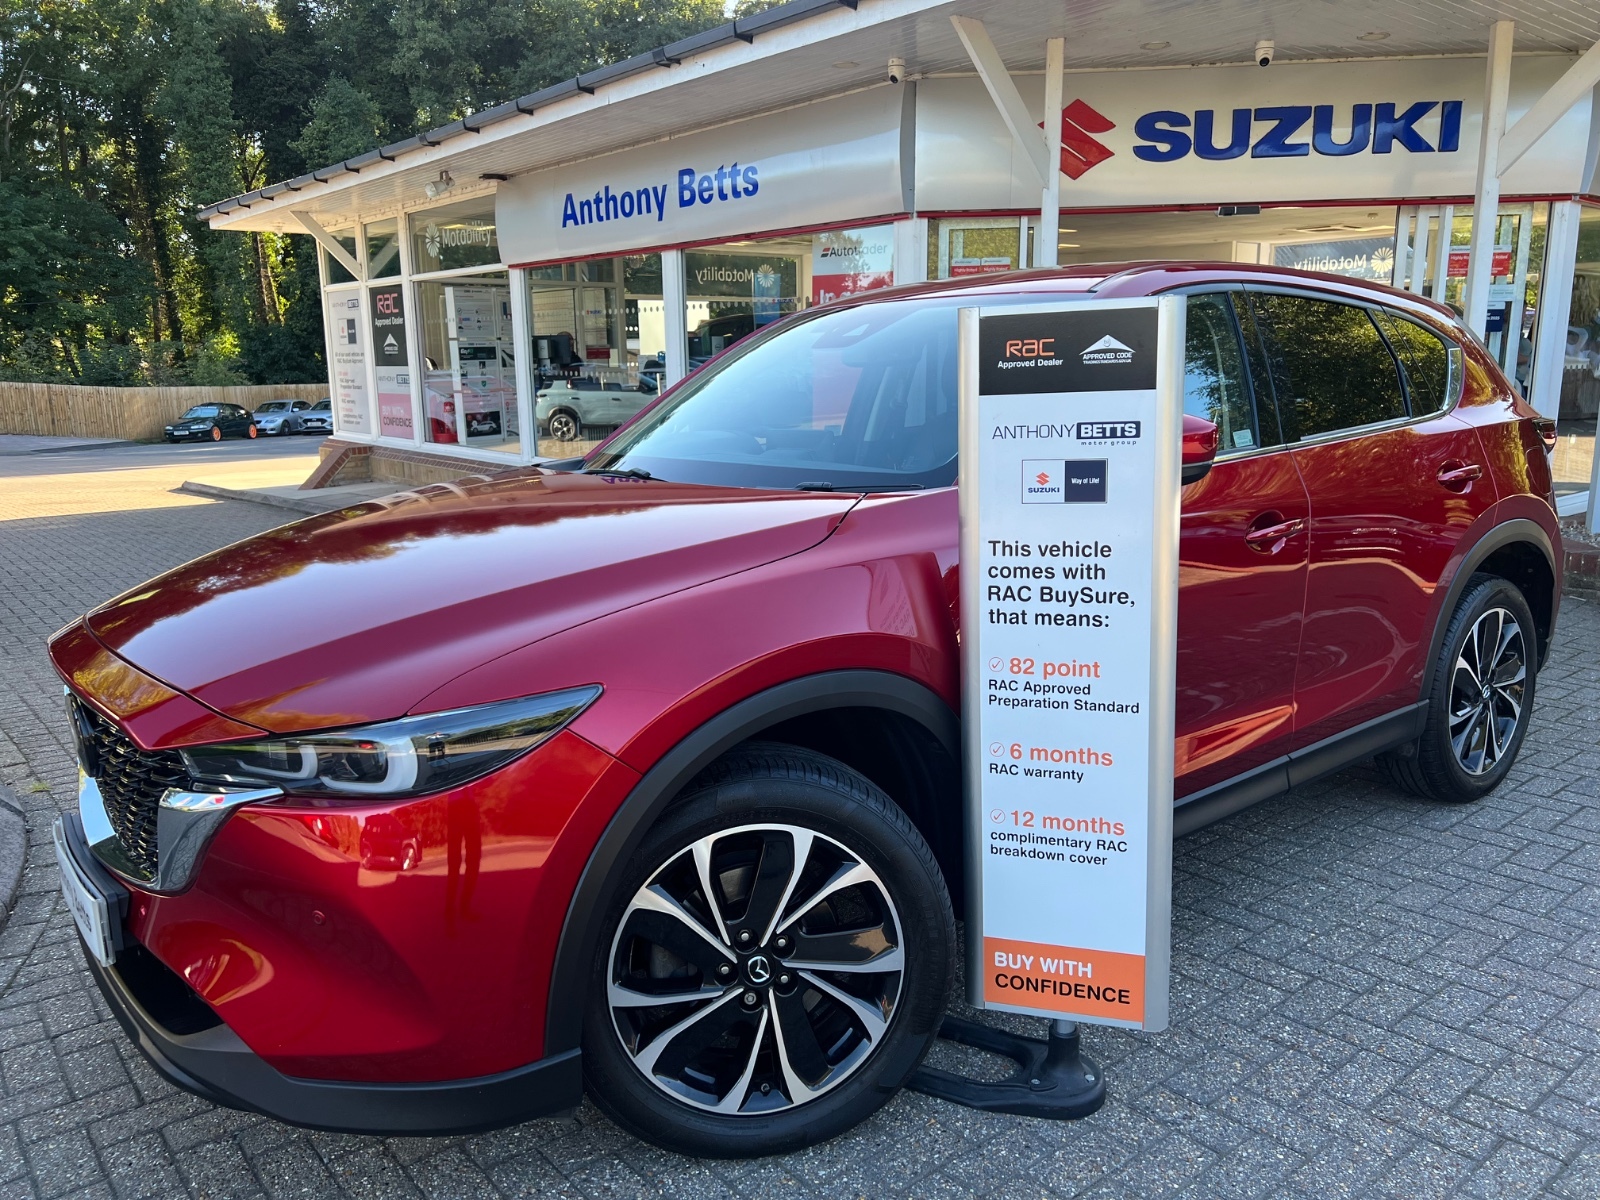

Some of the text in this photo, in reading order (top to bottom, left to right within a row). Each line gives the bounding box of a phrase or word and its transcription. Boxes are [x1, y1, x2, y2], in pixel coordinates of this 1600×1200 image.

[1132, 100, 1463, 162] SUZUKI
[562, 162, 759, 228] Anthony Betts
[442, 220, 491, 248] Motability
[829, 243, 888, 257] Autotrader
[375, 316, 403, 327] Approved Dealer
[998, 358, 1063, 369] Approved Dealer
[383, 416, 412, 428] CONFIDENCE
[992, 423, 1136, 439] ANTHONY BETTS
[988, 540, 1112, 558] This vehicle
[988, 563, 1106, 580] comes with
[988, 585, 1135, 607] RAC BuySure,
[988, 608, 1109, 628] that means:
[1009, 657, 1100, 680] 82 point
[988, 679, 1091, 695] RAC Approved
[988, 694, 1140, 714] Preparation Standard
[1010, 743, 1113, 766] 6 months
[989, 763, 1084, 783] RAC warranty
[1011, 810, 1125, 836] 12 months
[990, 831, 1128, 852] complimentary RAC
[990, 844, 1108, 865] breakdown cover
[994, 951, 1092, 978] BUY WITH
[995, 973, 1131, 1005] CONFIDENCE
